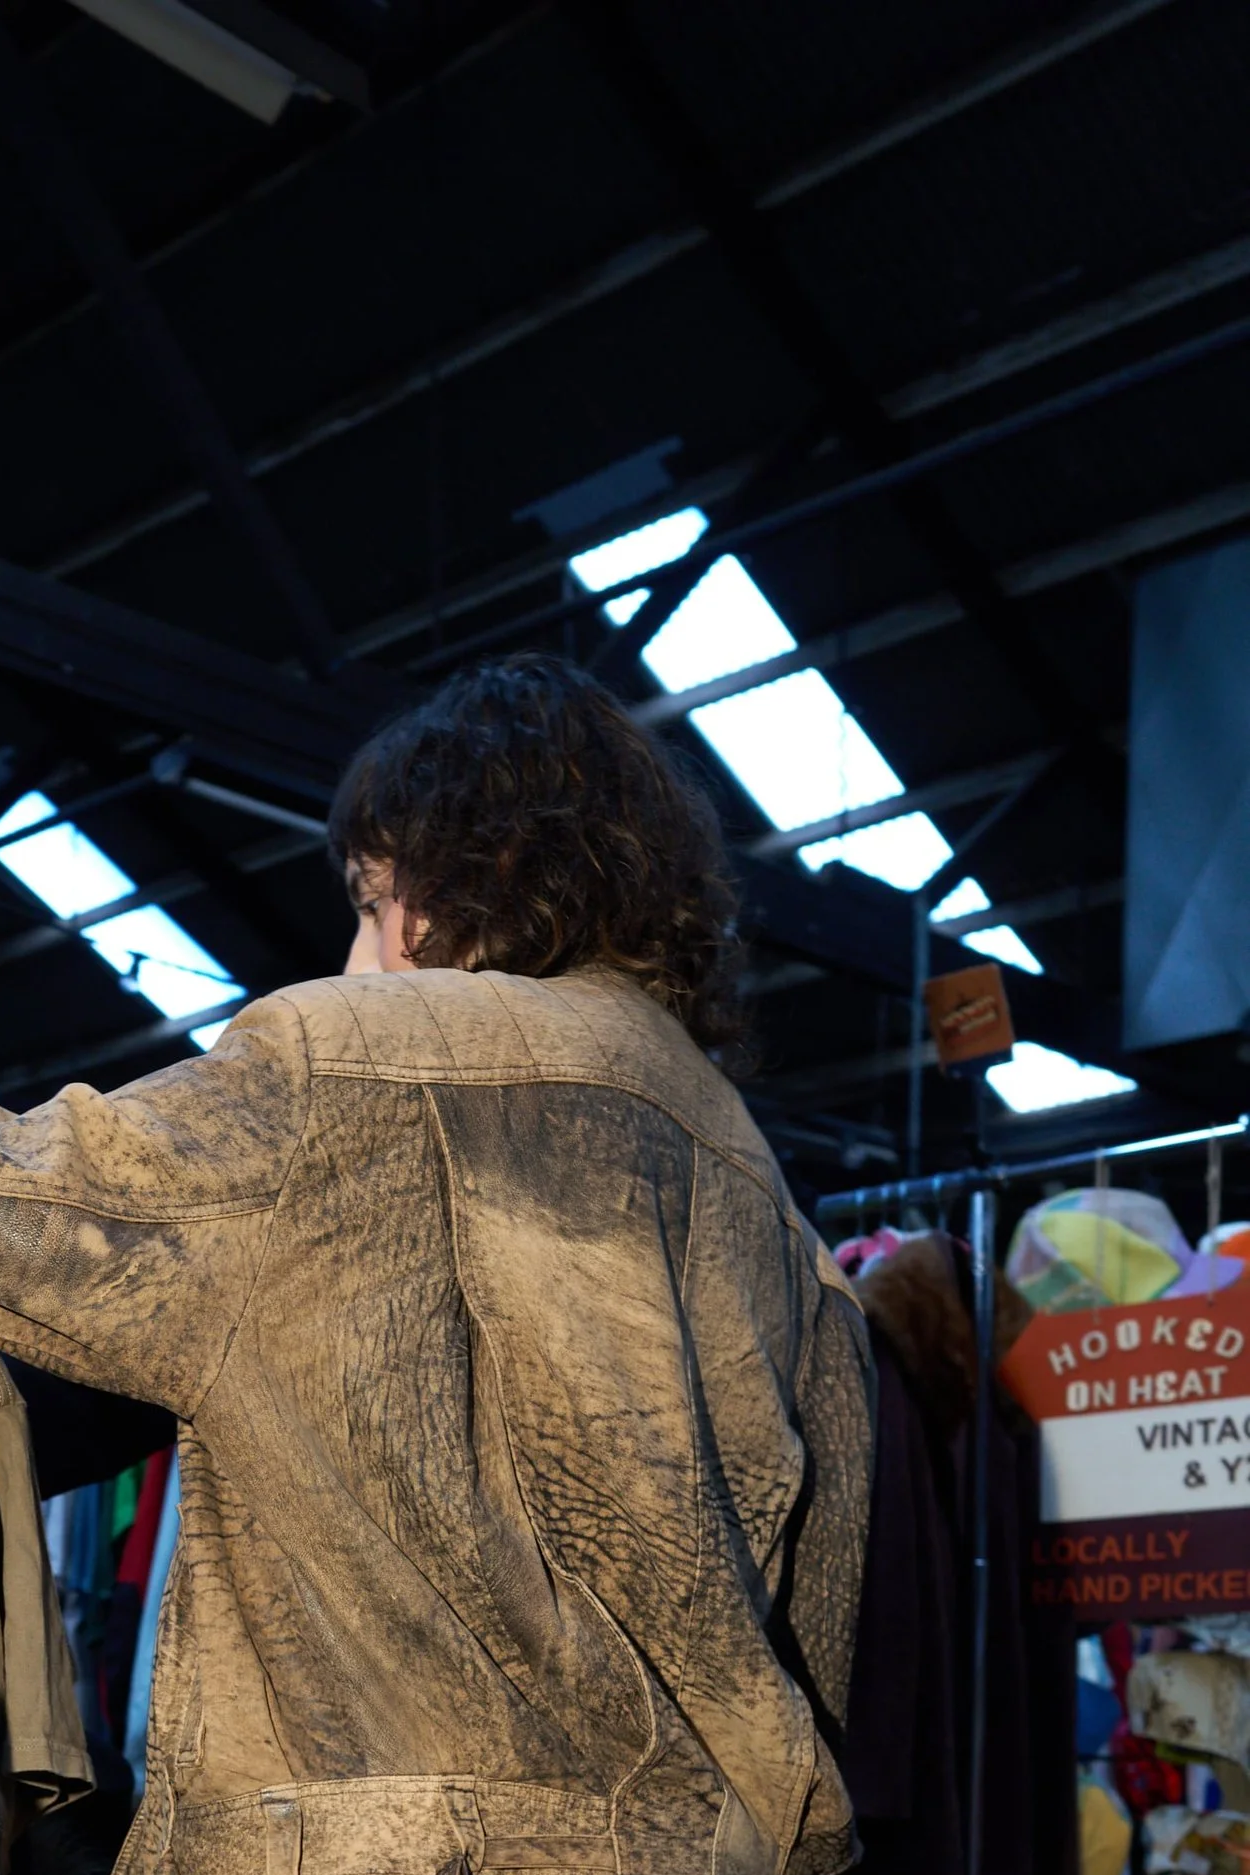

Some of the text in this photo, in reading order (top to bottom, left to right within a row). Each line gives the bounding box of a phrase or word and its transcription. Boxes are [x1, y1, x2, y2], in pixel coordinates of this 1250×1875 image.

[1048, 1316, 1244, 1375] HOOKED
[1065, 1365, 1229, 1412] ON HEAT
[1183, 1455, 1250, 1489] & Y
[1032, 1531, 1189, 1565] LOCALLY
[1030, 1568, 1250, 1605] HAND PICKE
